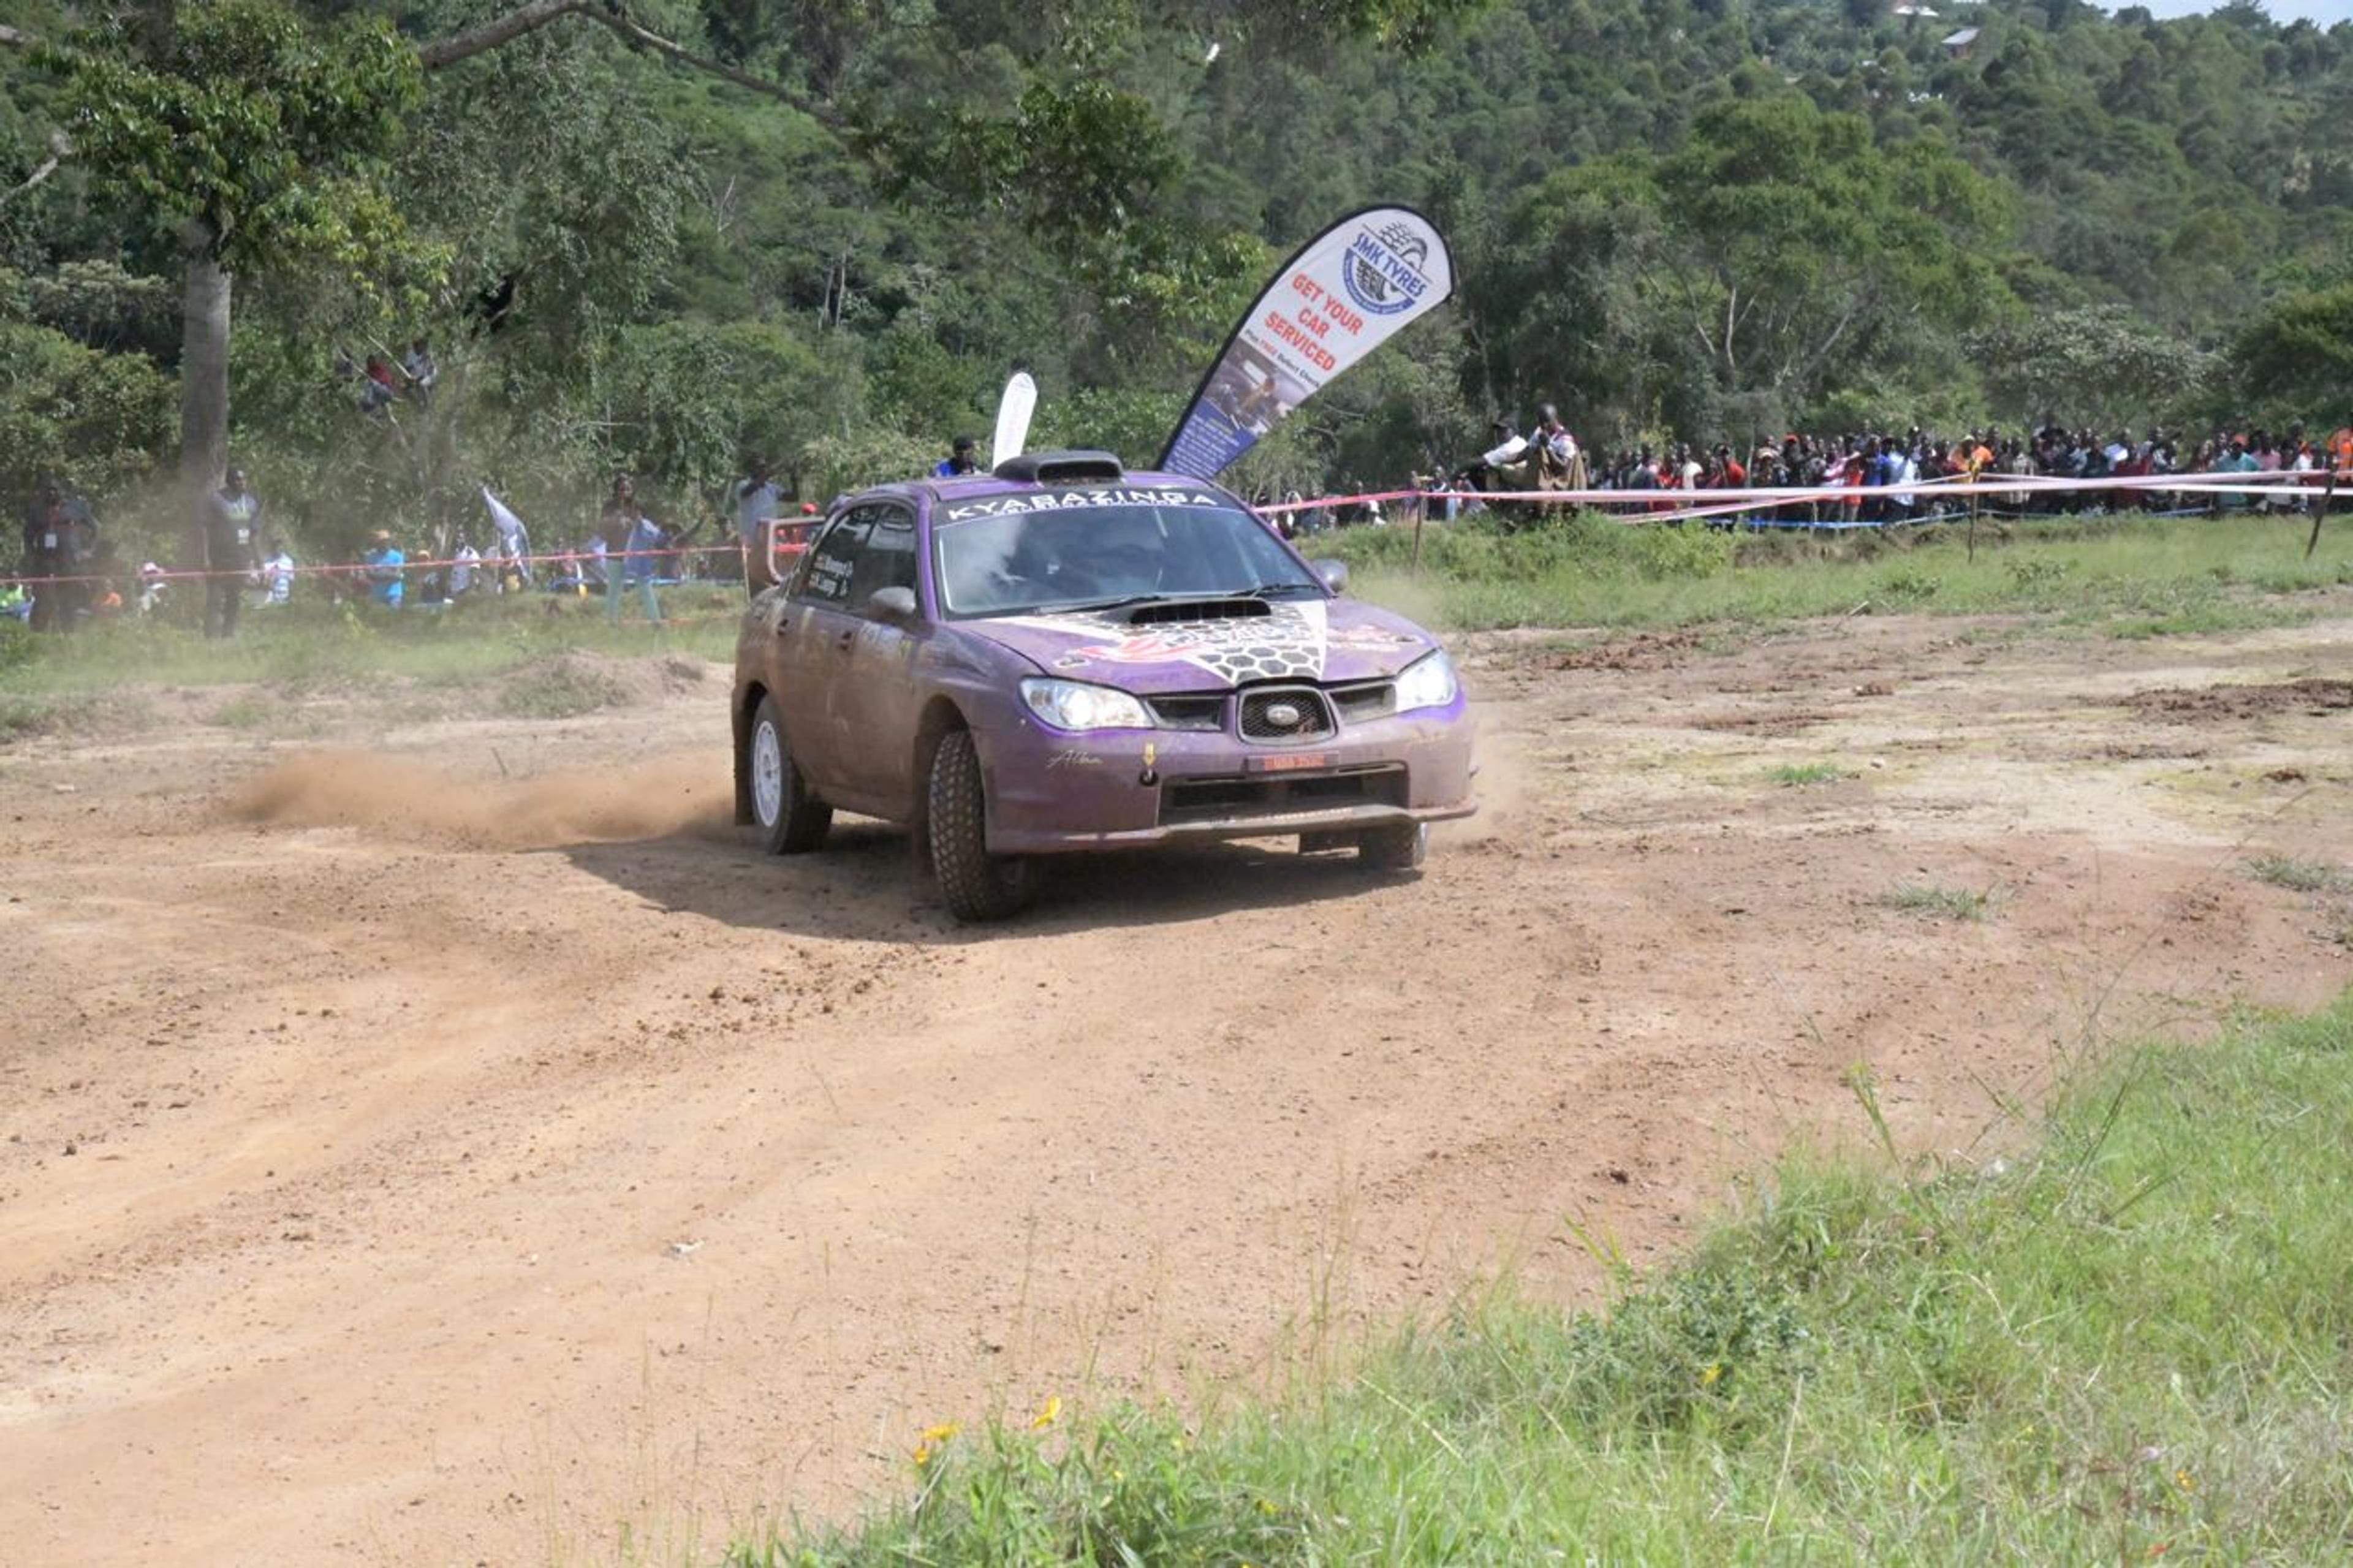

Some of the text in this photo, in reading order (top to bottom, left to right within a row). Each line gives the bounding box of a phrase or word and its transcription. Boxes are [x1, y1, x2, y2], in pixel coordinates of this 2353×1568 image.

[1353, 232, 1385, 265] SMK
[1382, 255, 1427, 297] TYRES
[1292, 273, 1324, 302] GET
[1324, 295, 1363, 335] YOUR
[1298, 308, 1330, 339] CAR
[1265, 311, 1336, 371] SERVICED
